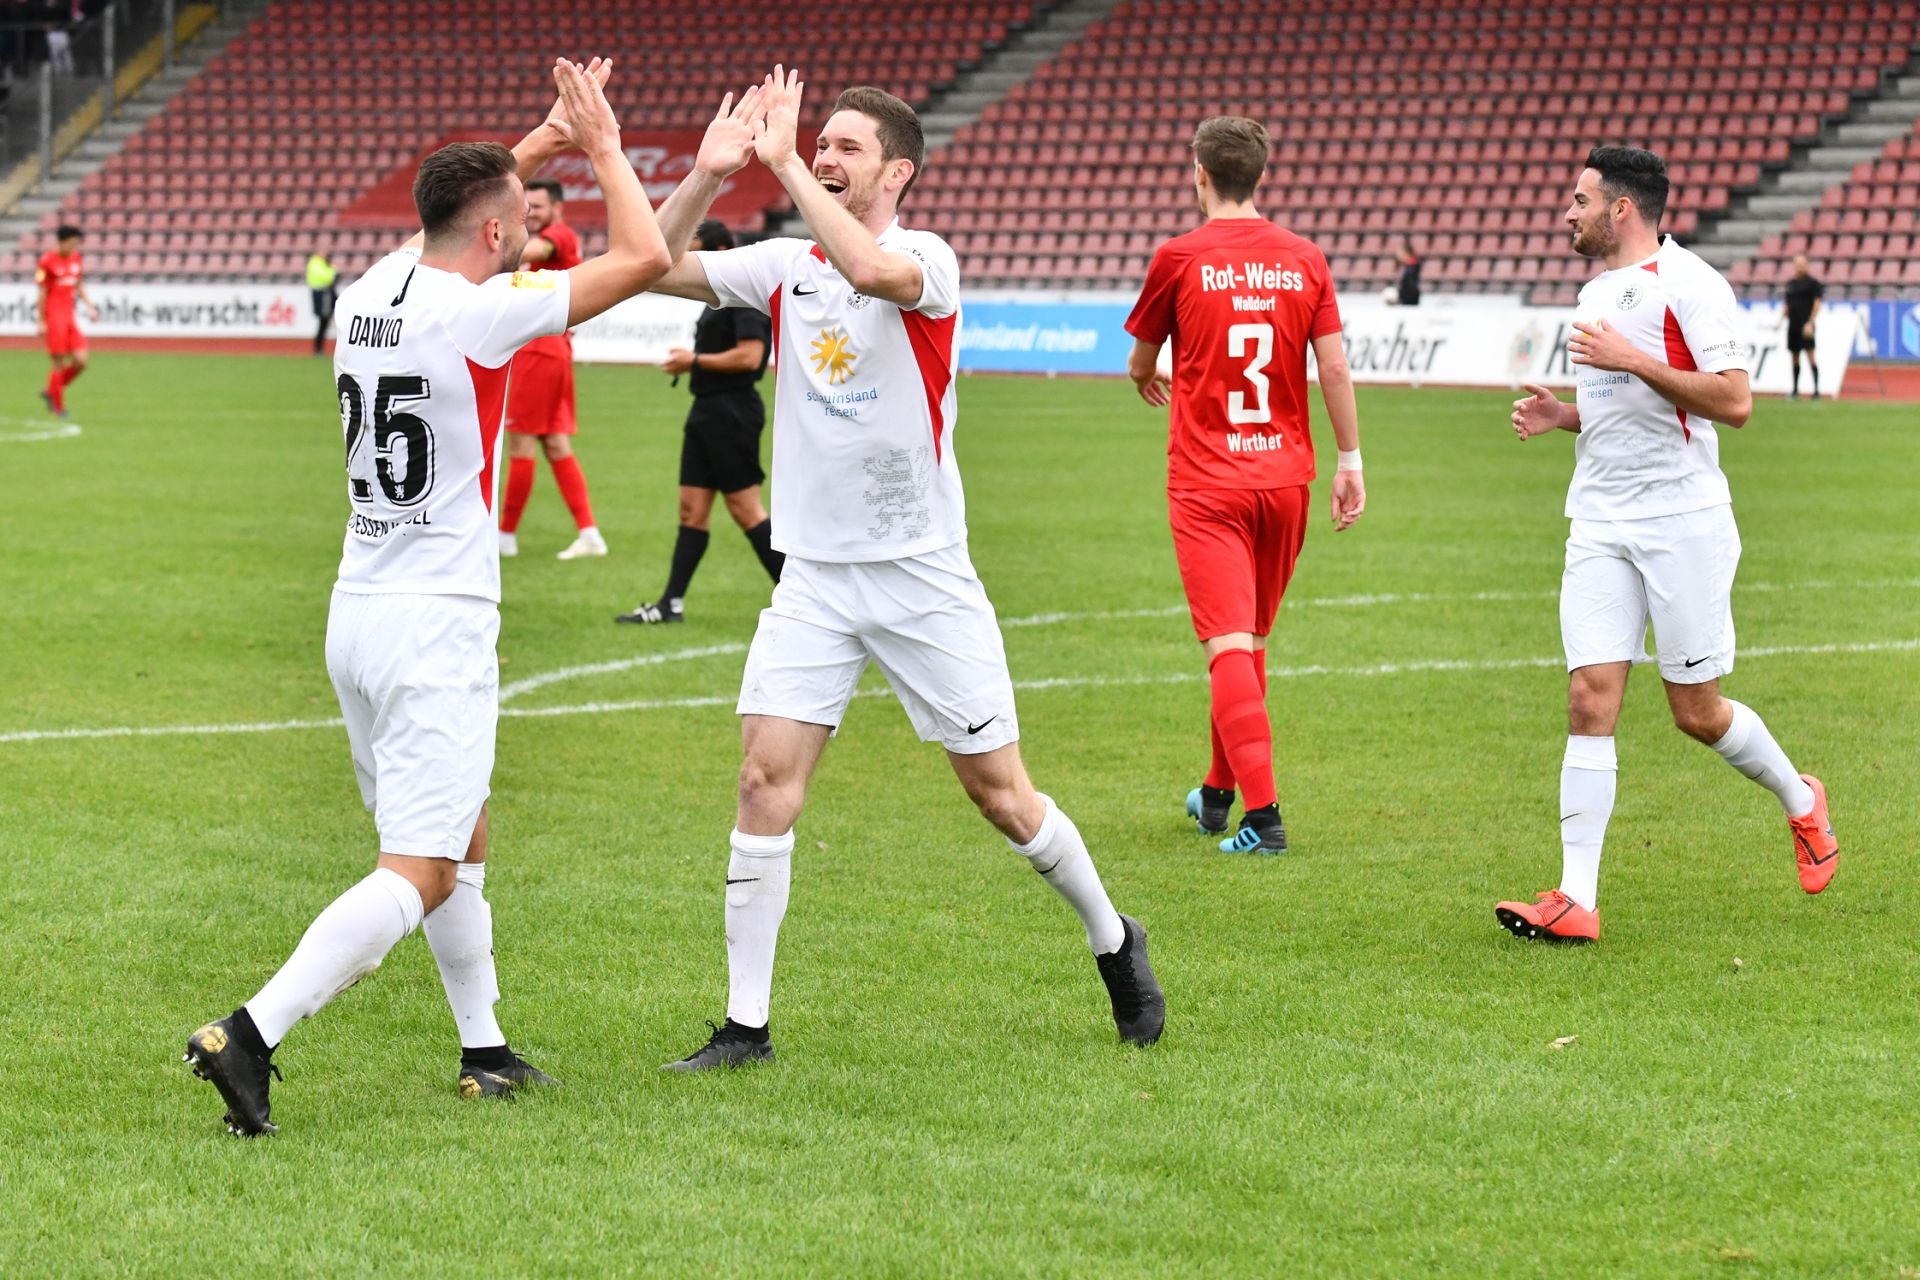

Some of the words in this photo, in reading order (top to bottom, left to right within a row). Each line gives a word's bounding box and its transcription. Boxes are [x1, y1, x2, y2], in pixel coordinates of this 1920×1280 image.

[1201, 262, 1303, 292] Rot-Weiss
[1232, 295, 1276, 311] Walldorf
[348, 315, 403, 348] DAWID
[1228, 323, 1274, 424] 3
[1587, 388, 1613, 399] reisen
[337, 373, 434, 507] 25
